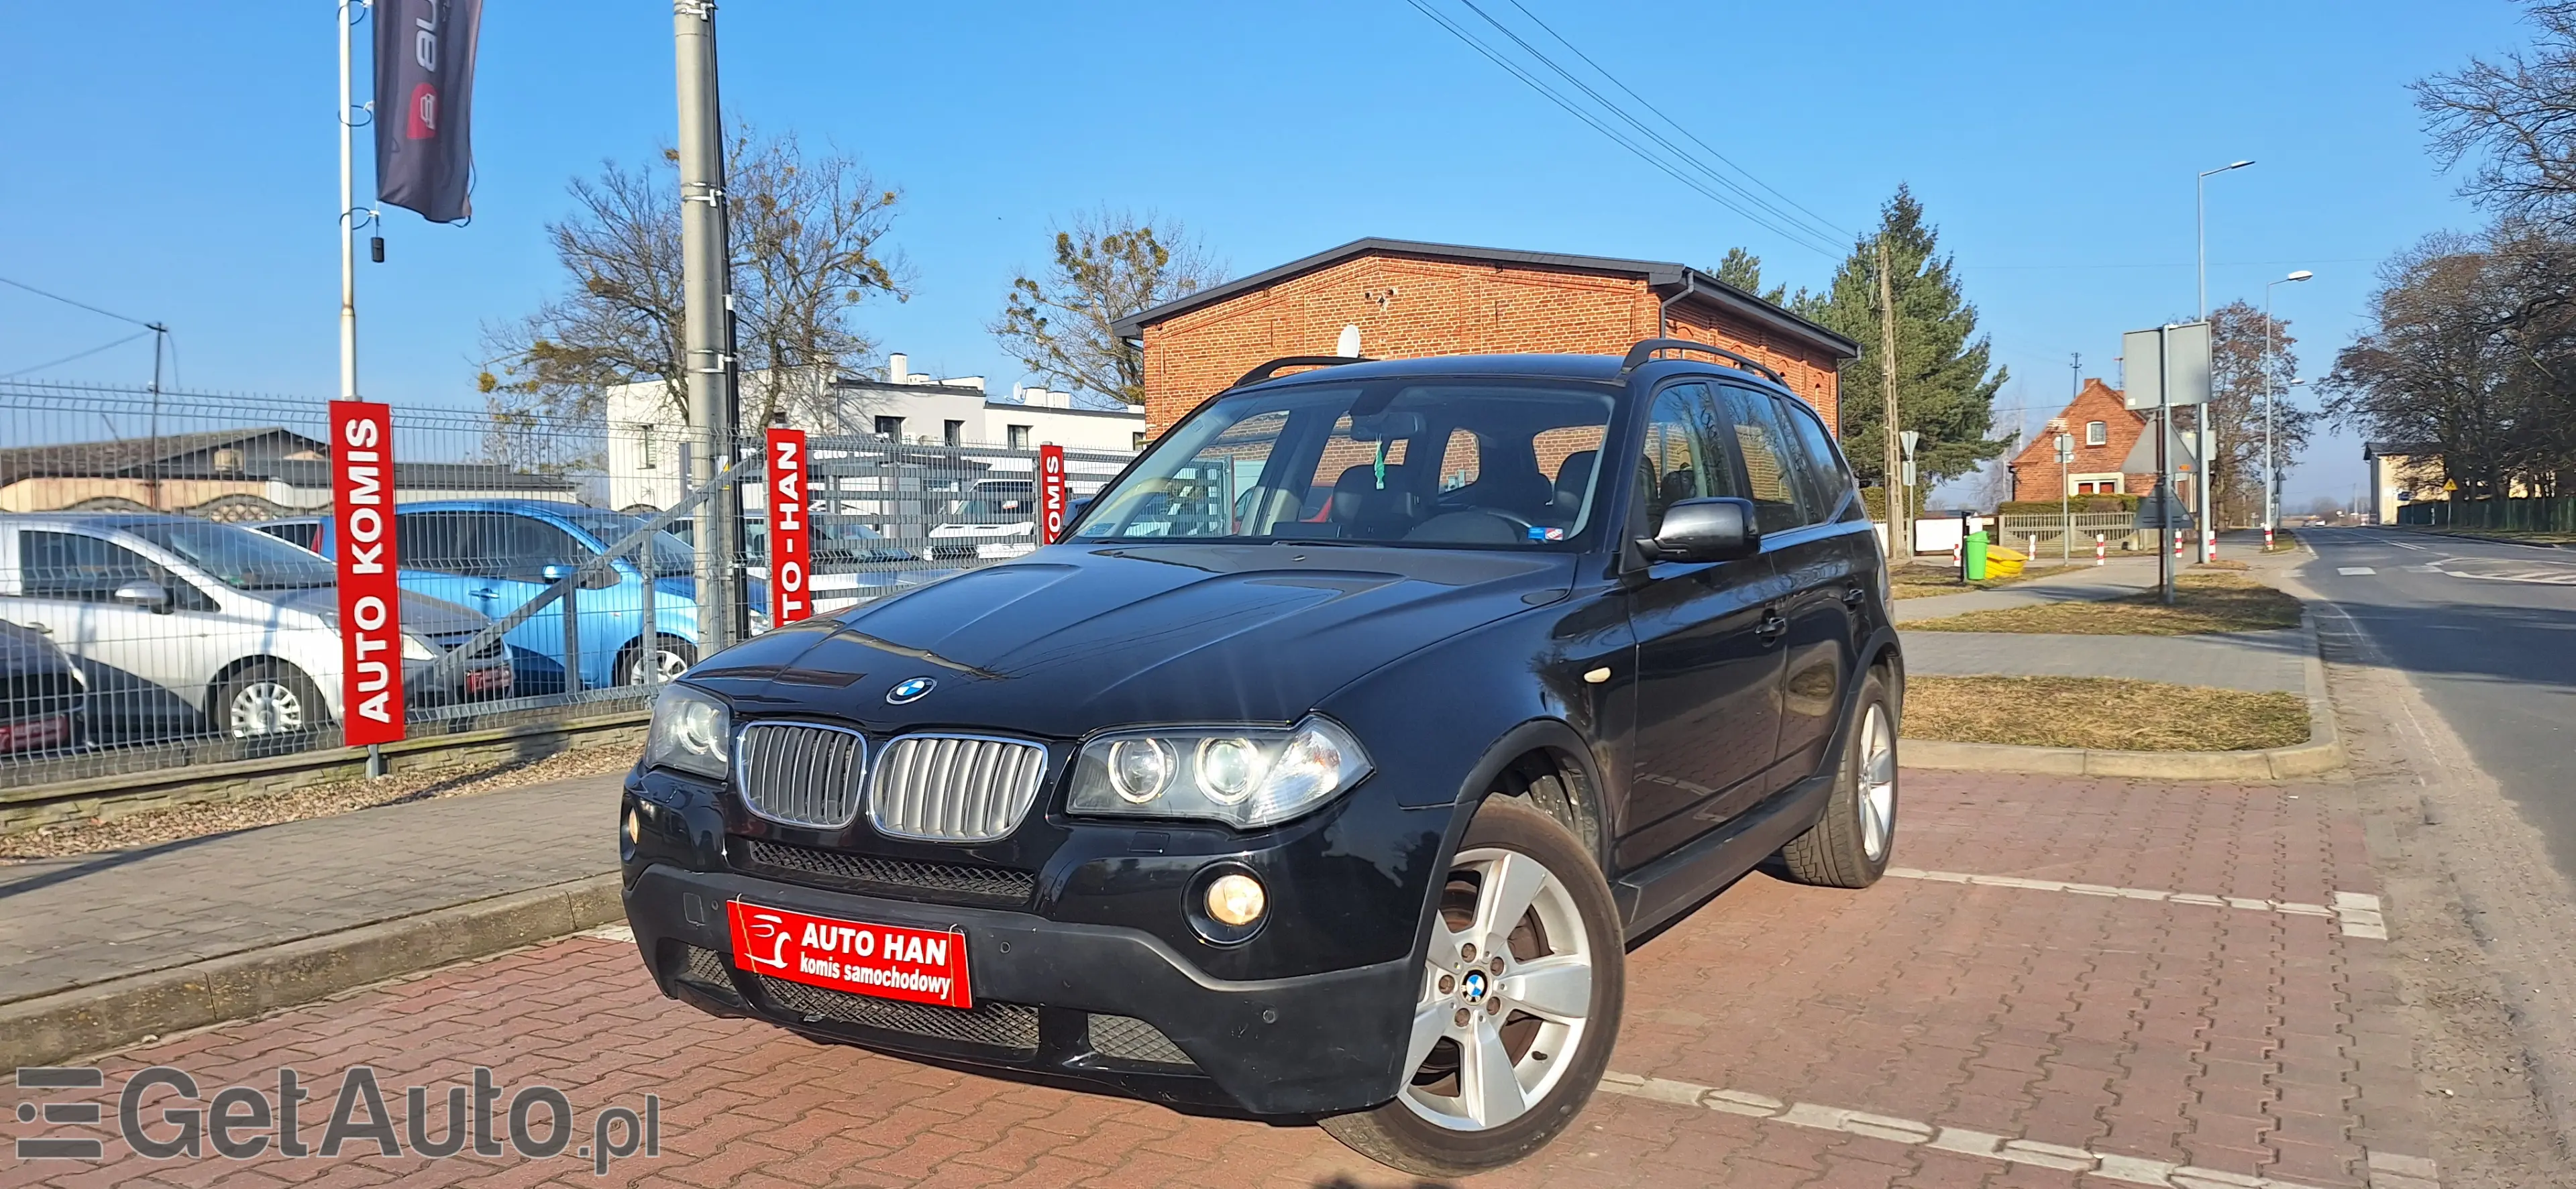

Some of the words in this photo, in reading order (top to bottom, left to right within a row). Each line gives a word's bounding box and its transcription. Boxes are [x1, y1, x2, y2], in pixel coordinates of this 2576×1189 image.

[345, 418, 384, 574] KOMIS
[354, 596, 390, 724] AUTO
[800, 951, 841, 979] komis
[843, 963, 951, 1000] samochodowy
[801, 922, 875, 957] AUTO
[883, 933, 947, 966] HAN
